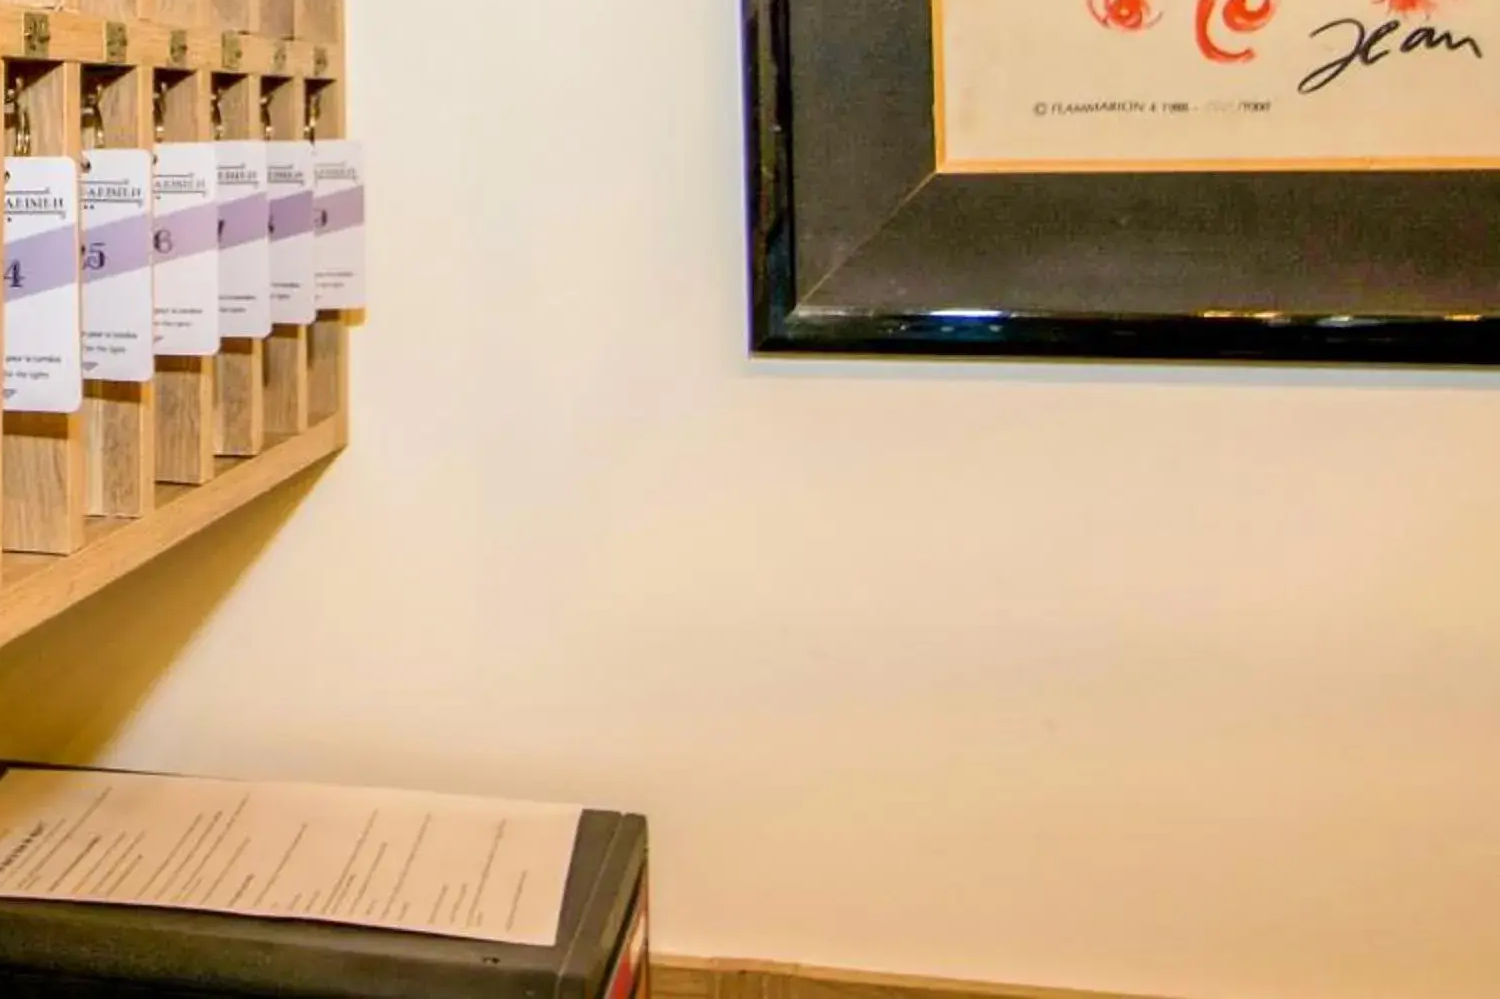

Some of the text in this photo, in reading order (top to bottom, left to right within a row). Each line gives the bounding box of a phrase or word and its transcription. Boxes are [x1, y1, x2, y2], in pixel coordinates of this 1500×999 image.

[1298, 17, 1482, 95] Jean
[1051, 100, 1145, 116] FLAMMARION
[80, 242, 107, 271] 5
[153, 229, 174, 255] 6
[3, 259, 26, 288] 4
